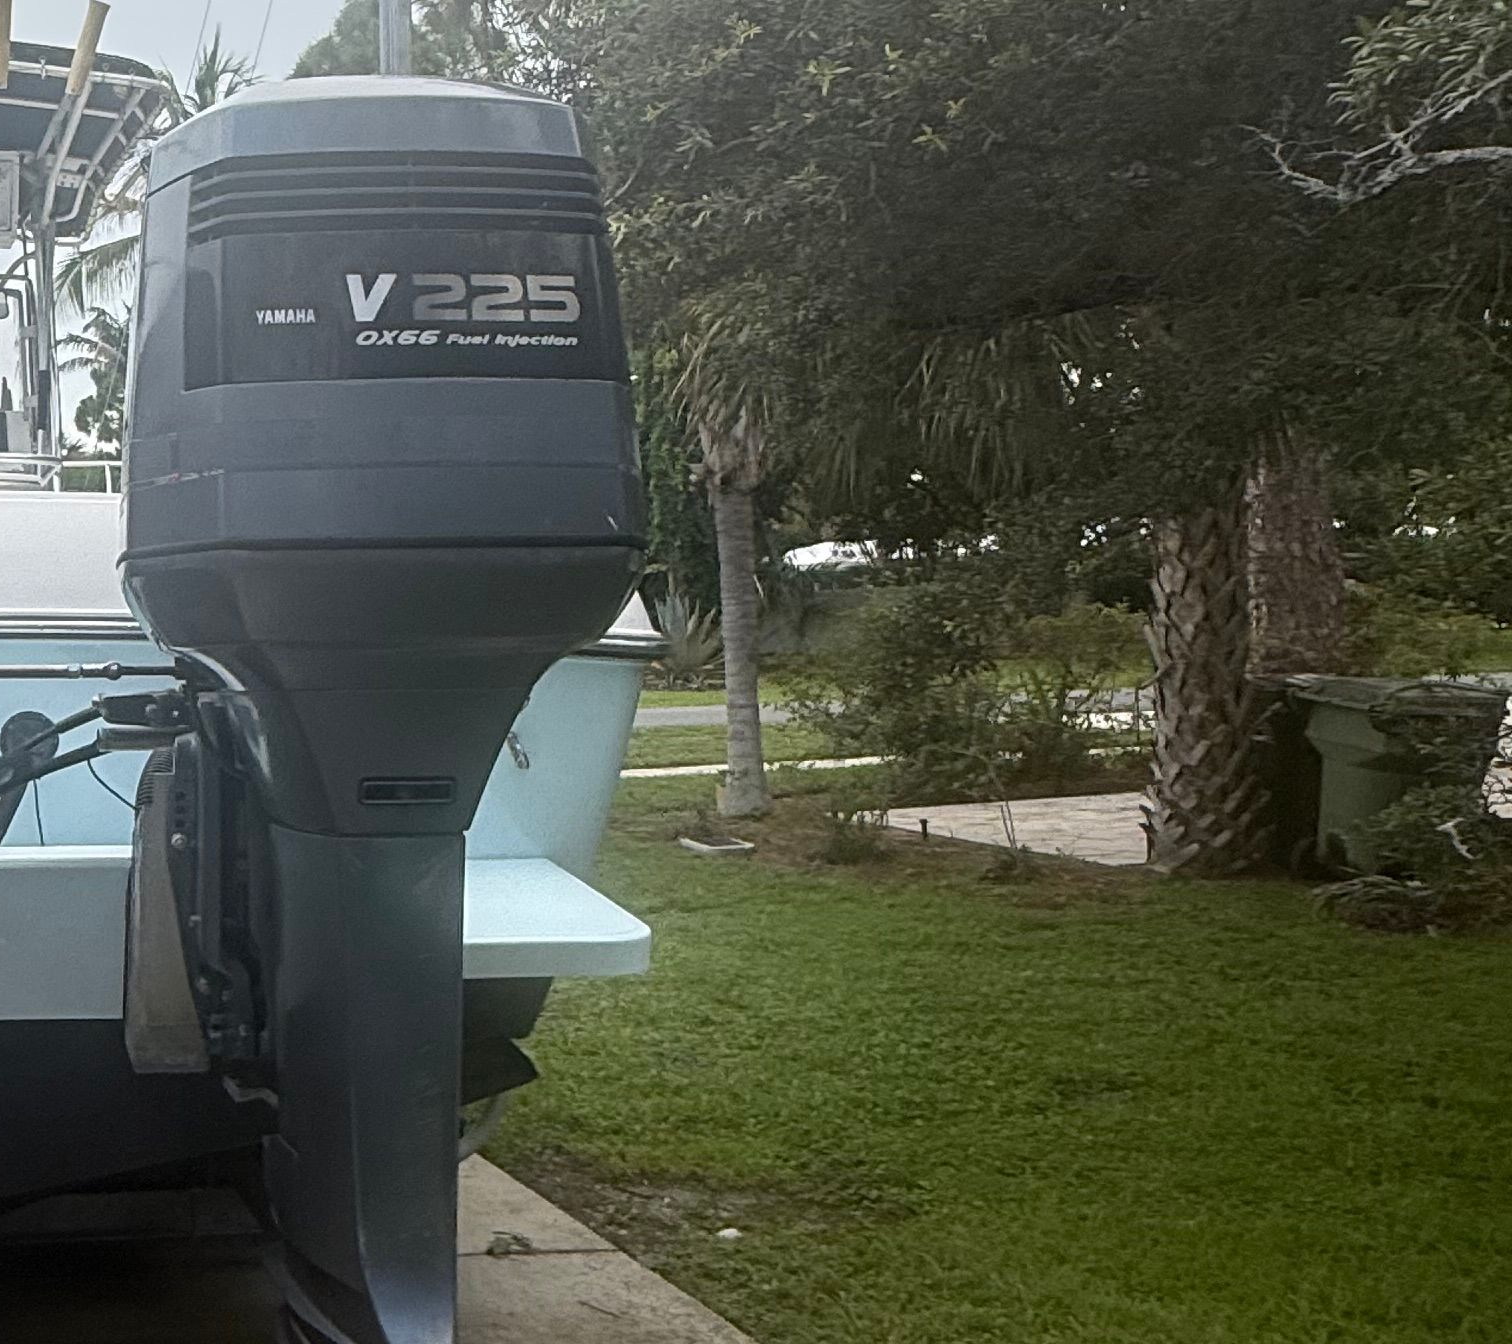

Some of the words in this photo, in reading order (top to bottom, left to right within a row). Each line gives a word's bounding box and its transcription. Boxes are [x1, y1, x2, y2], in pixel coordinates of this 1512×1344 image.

[345, 273, 398, 322] V
[411, 273, 581, 323] 225
[255, 308, 316, 325] YAMAHA
[355, 329, 442, 346] OX66
[446, 333, 490, 346] Fuel
[494, 333, 579, 348] Injection
